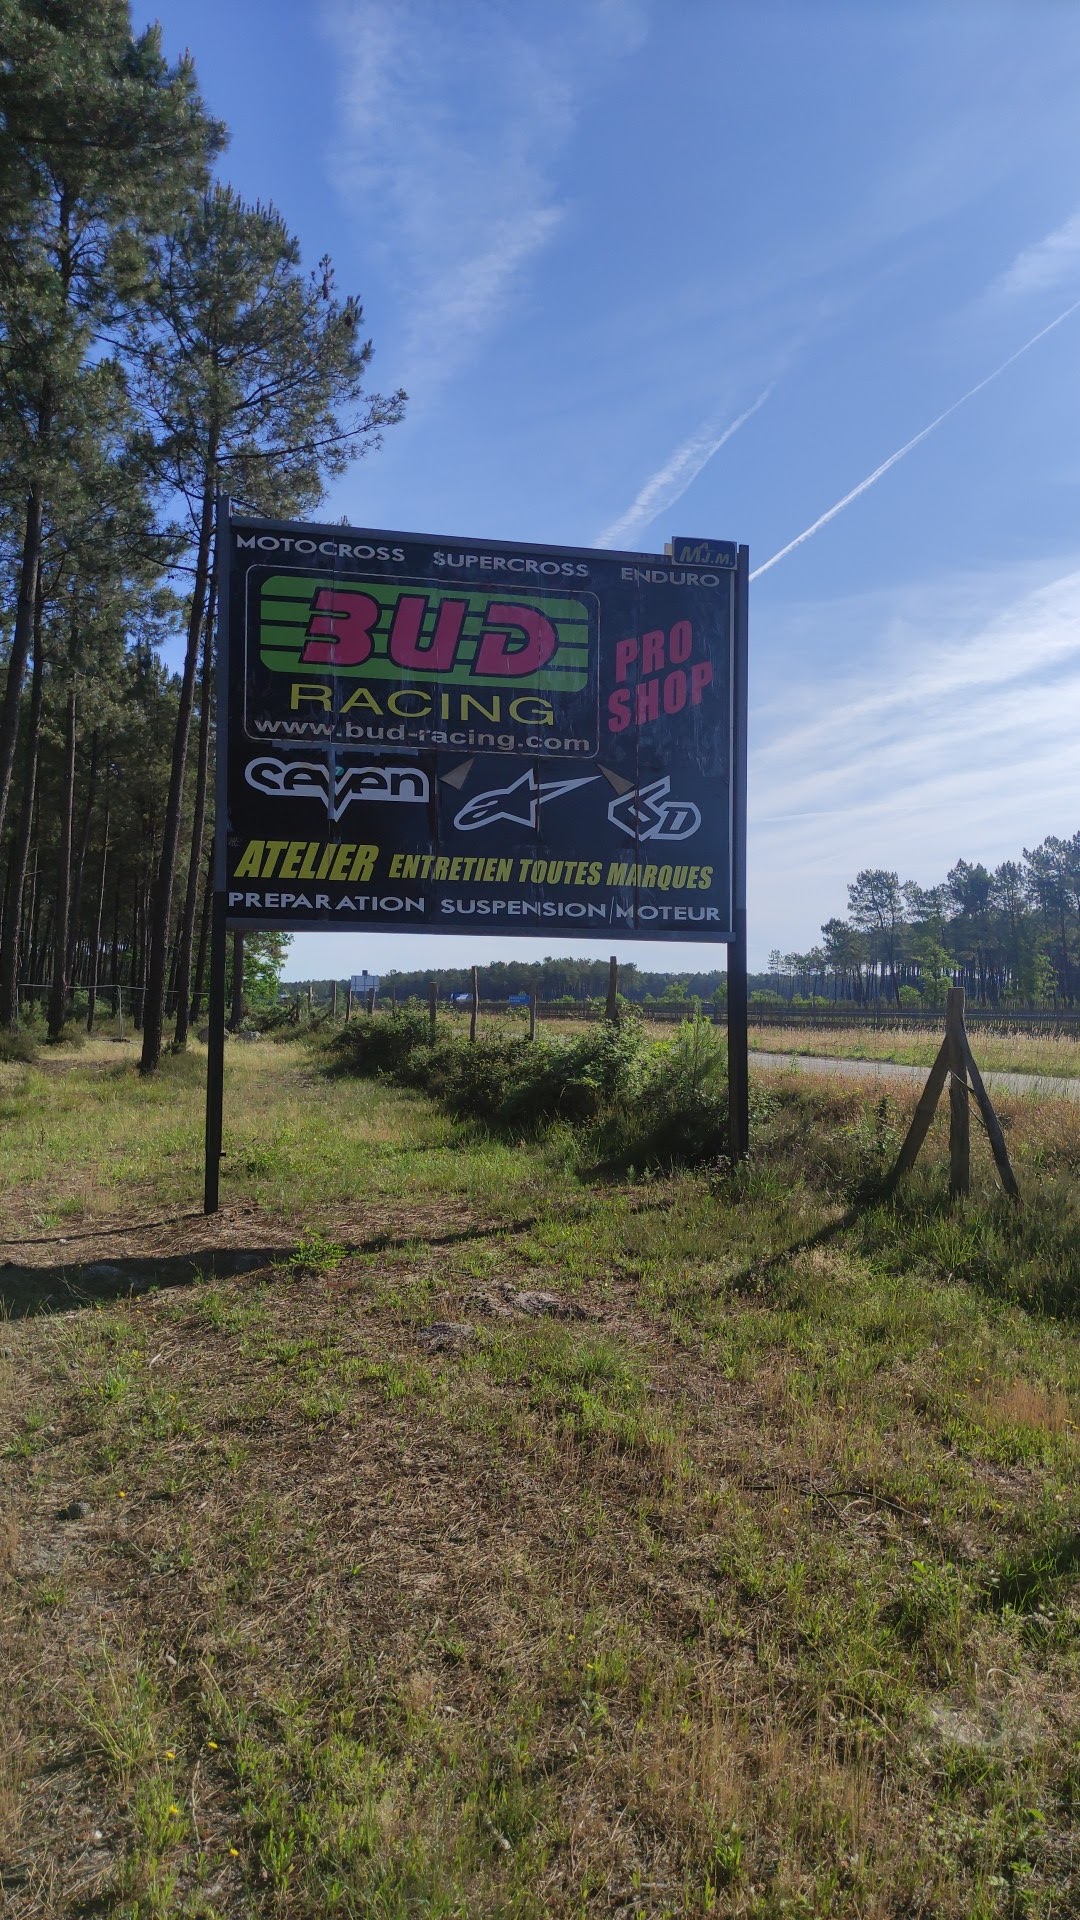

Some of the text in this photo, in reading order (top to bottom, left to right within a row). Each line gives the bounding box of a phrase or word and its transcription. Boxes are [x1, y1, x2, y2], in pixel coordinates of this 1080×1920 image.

[236, 533, 721, 588] MOTOCROSS SUPERCROSS ENDURO
[300, 588, 558, 678] BUD
[615, 620, 693, 683] PRO
[290, 683, 555, 726] RACING
[607, 661, 714, 733] SHOP
[253, 719, 590, 751] www.bud-racing.com
[233, 839, 714, 891] ATELIER ENTRETIEN TOUTES MARQUES
[228, 891, 425, 914] PREPARATION
[440, 898, 606, 918] SUSPENSION
[615, 903, 721, 921] MOTEUR
